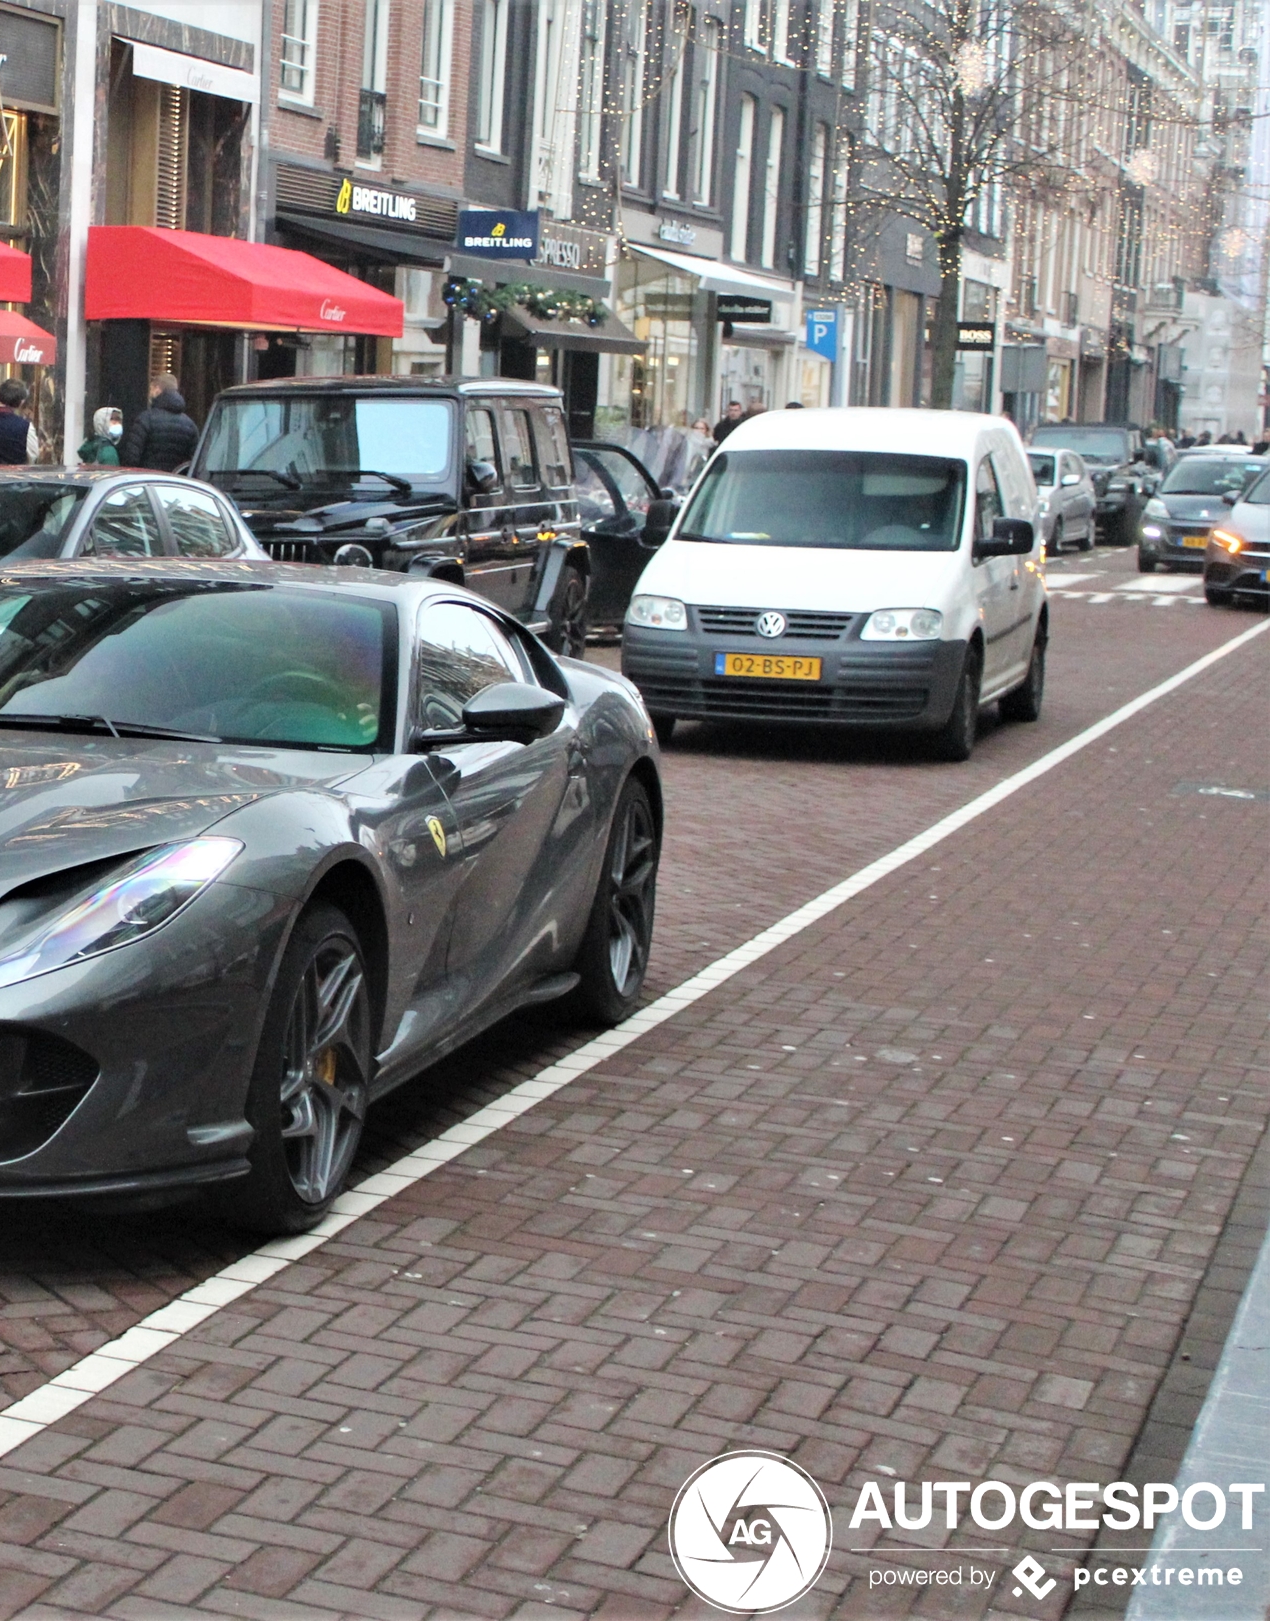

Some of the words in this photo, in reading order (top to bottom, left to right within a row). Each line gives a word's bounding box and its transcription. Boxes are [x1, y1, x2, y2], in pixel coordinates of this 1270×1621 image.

[352, 186, 417, 221] BREITLING
[464, 237, 533, 248] BREITLING
[320, 298, 346, 321] Cartier
[814, 324, 828, 345] P
[959, 329, 992, 341] BOSS
[14, 337, 43, 363] Cartier
[732, 657, 813, 677] 02-BS-PJ
